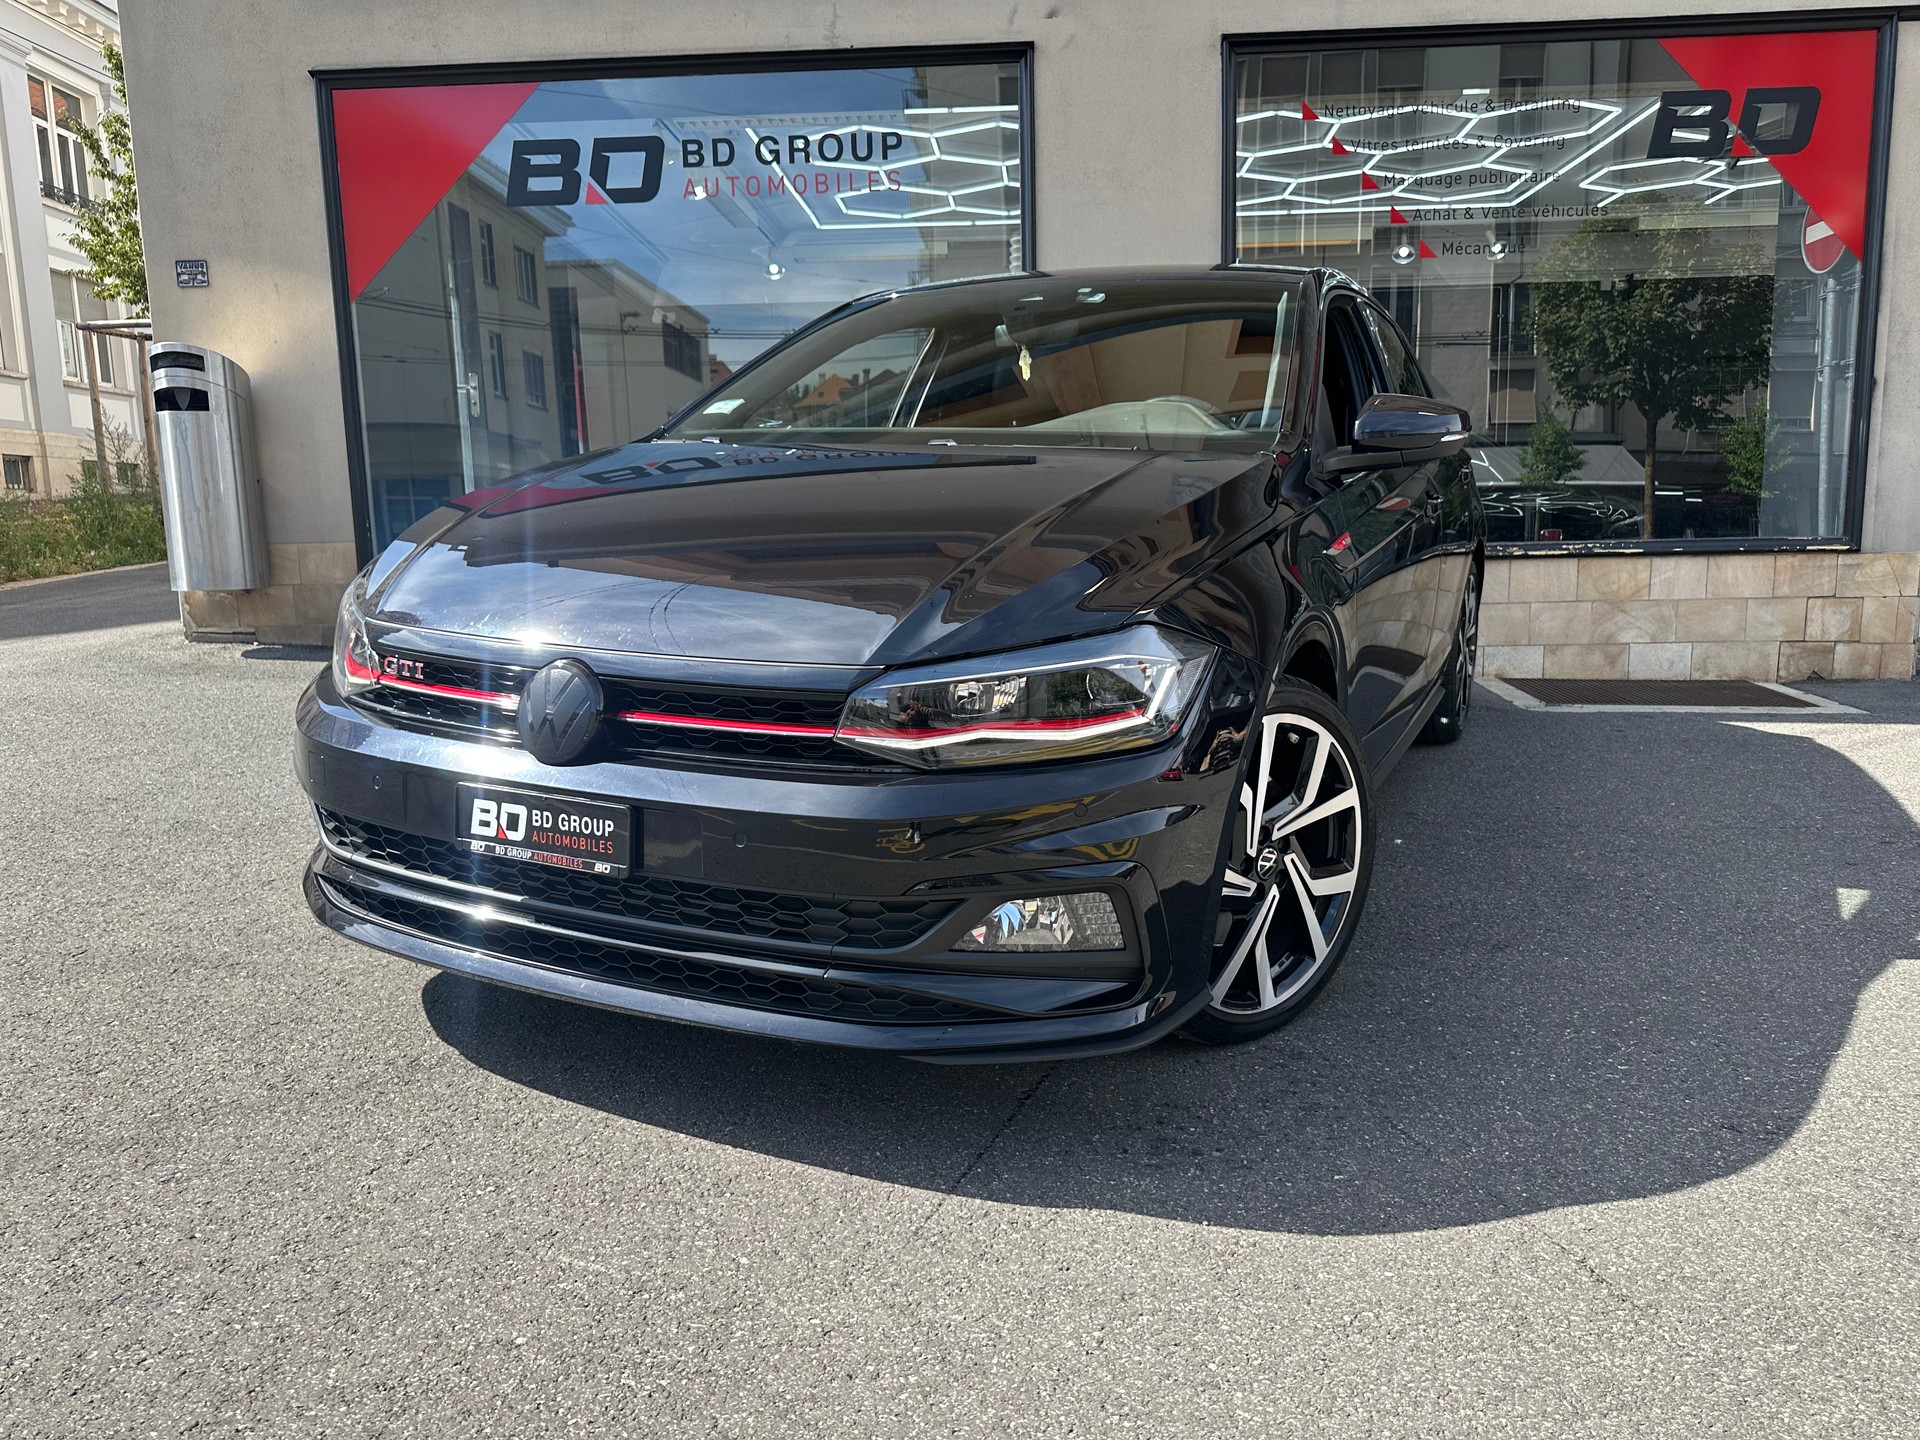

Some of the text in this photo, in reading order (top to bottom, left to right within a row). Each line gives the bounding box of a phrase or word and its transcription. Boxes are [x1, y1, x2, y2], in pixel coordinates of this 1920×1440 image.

[1324, 104, 1405, 119] Nettoyage
[1412, 99, 1478, 115] véhicule
[1485, 99, 1496, 111] &
[1646, 86, 1822, 159] BD
[682, 131, 903, 168] BD GROUP
[1350, 134, 1566, 152] Vitres teintées & Covering
[507, 135, 665, 207] BD
[1383, 173, 1463, 189] Marquage
[683, 170, 902, 199] AUTOMOBILES
[1412, 204, 1609, 222] Achat & Vente véhicules
[1441, 241, 1526, 256] Mécanque
[383, 655, 425, 680] GTI
[470, 798, 528, 842] BD
[532, 809, 615, 837] BD GROUP
[532, 830, 614, 854] AUTOMOBILES
[495, 845, 507, 856] BD
[507, 846, 532, 860] GROUP
[533, 852, 583, 869] AUTOMOBILES
